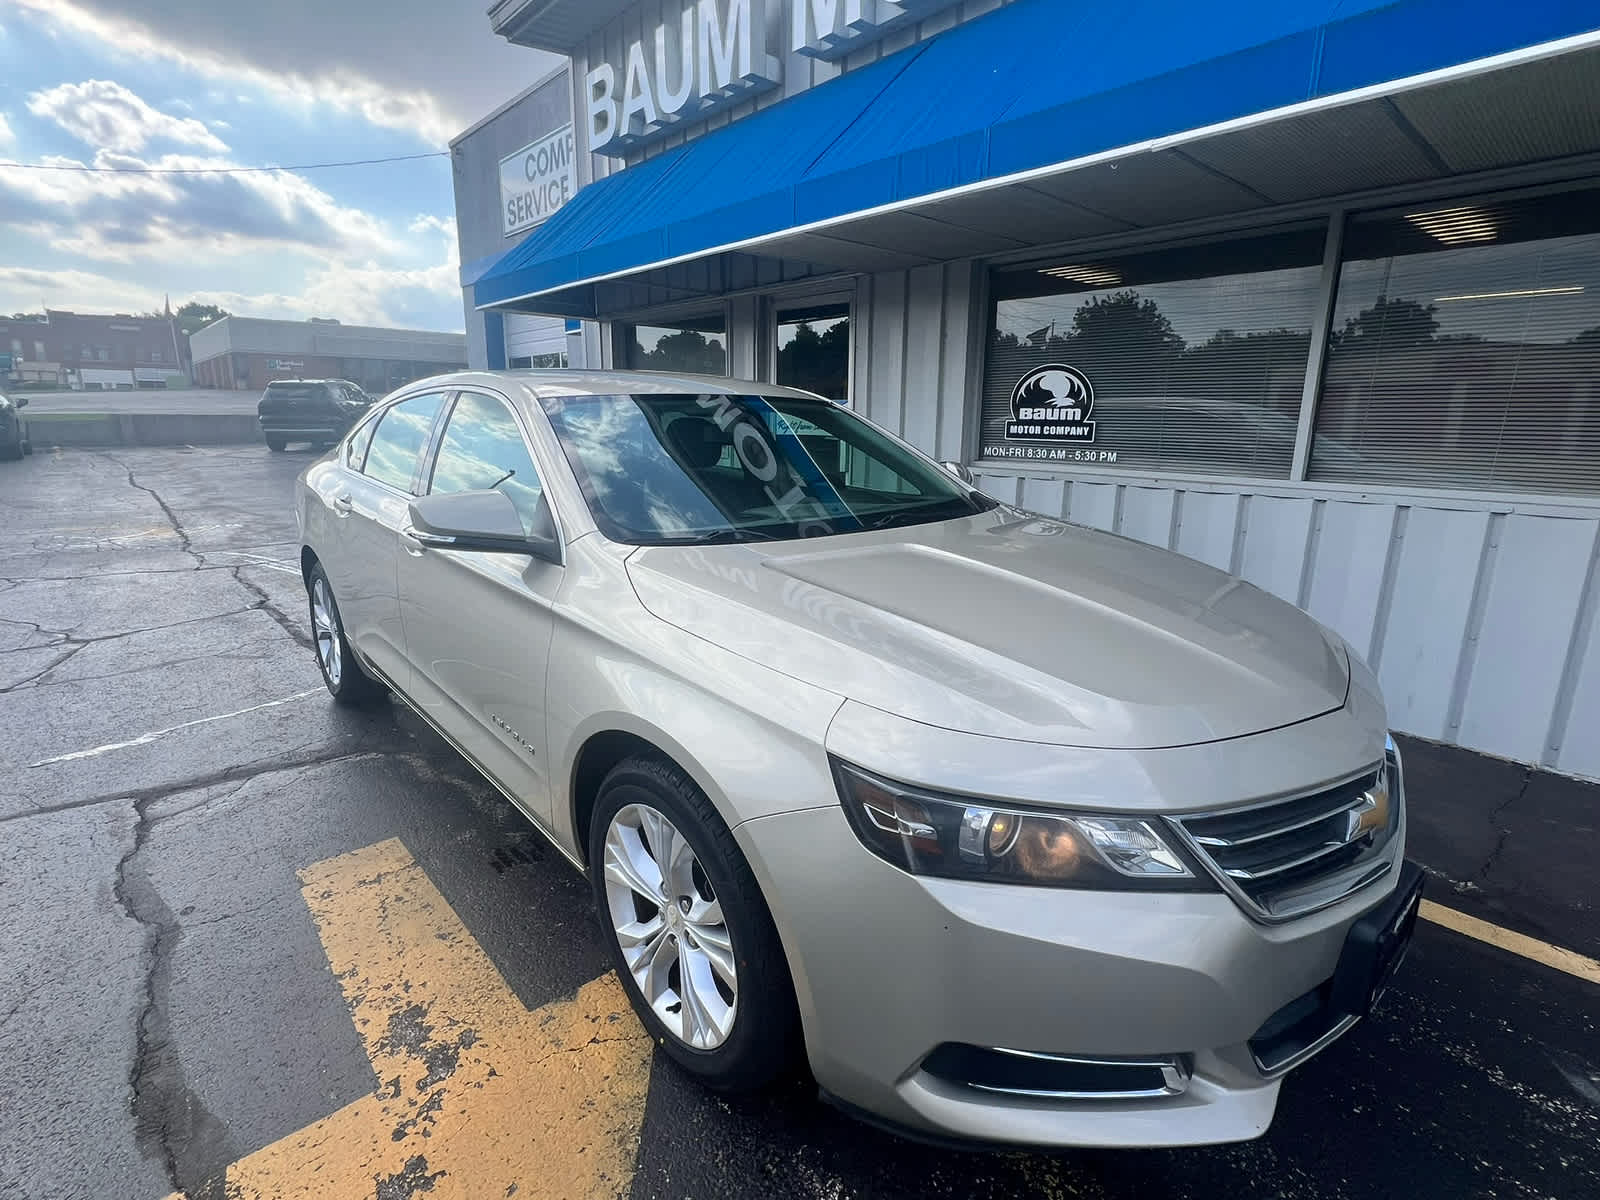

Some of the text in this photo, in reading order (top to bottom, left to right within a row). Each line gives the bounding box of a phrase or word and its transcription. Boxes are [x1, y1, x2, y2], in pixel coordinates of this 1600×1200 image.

[585, 0, 753, 152] BAUM
[507, 176, 569, 226] SERVICE
[1009, 425, 1090, 436] MOTOR COMPANY
[983, 446, 1025, 457] MON-FRI
[1027, 448, 1047, 459] 8:30
[1049, 449, 1066, 460] AM
[1074, 450, 1097, 461] 5:30
[1099, 451, 1118, 462] PM
